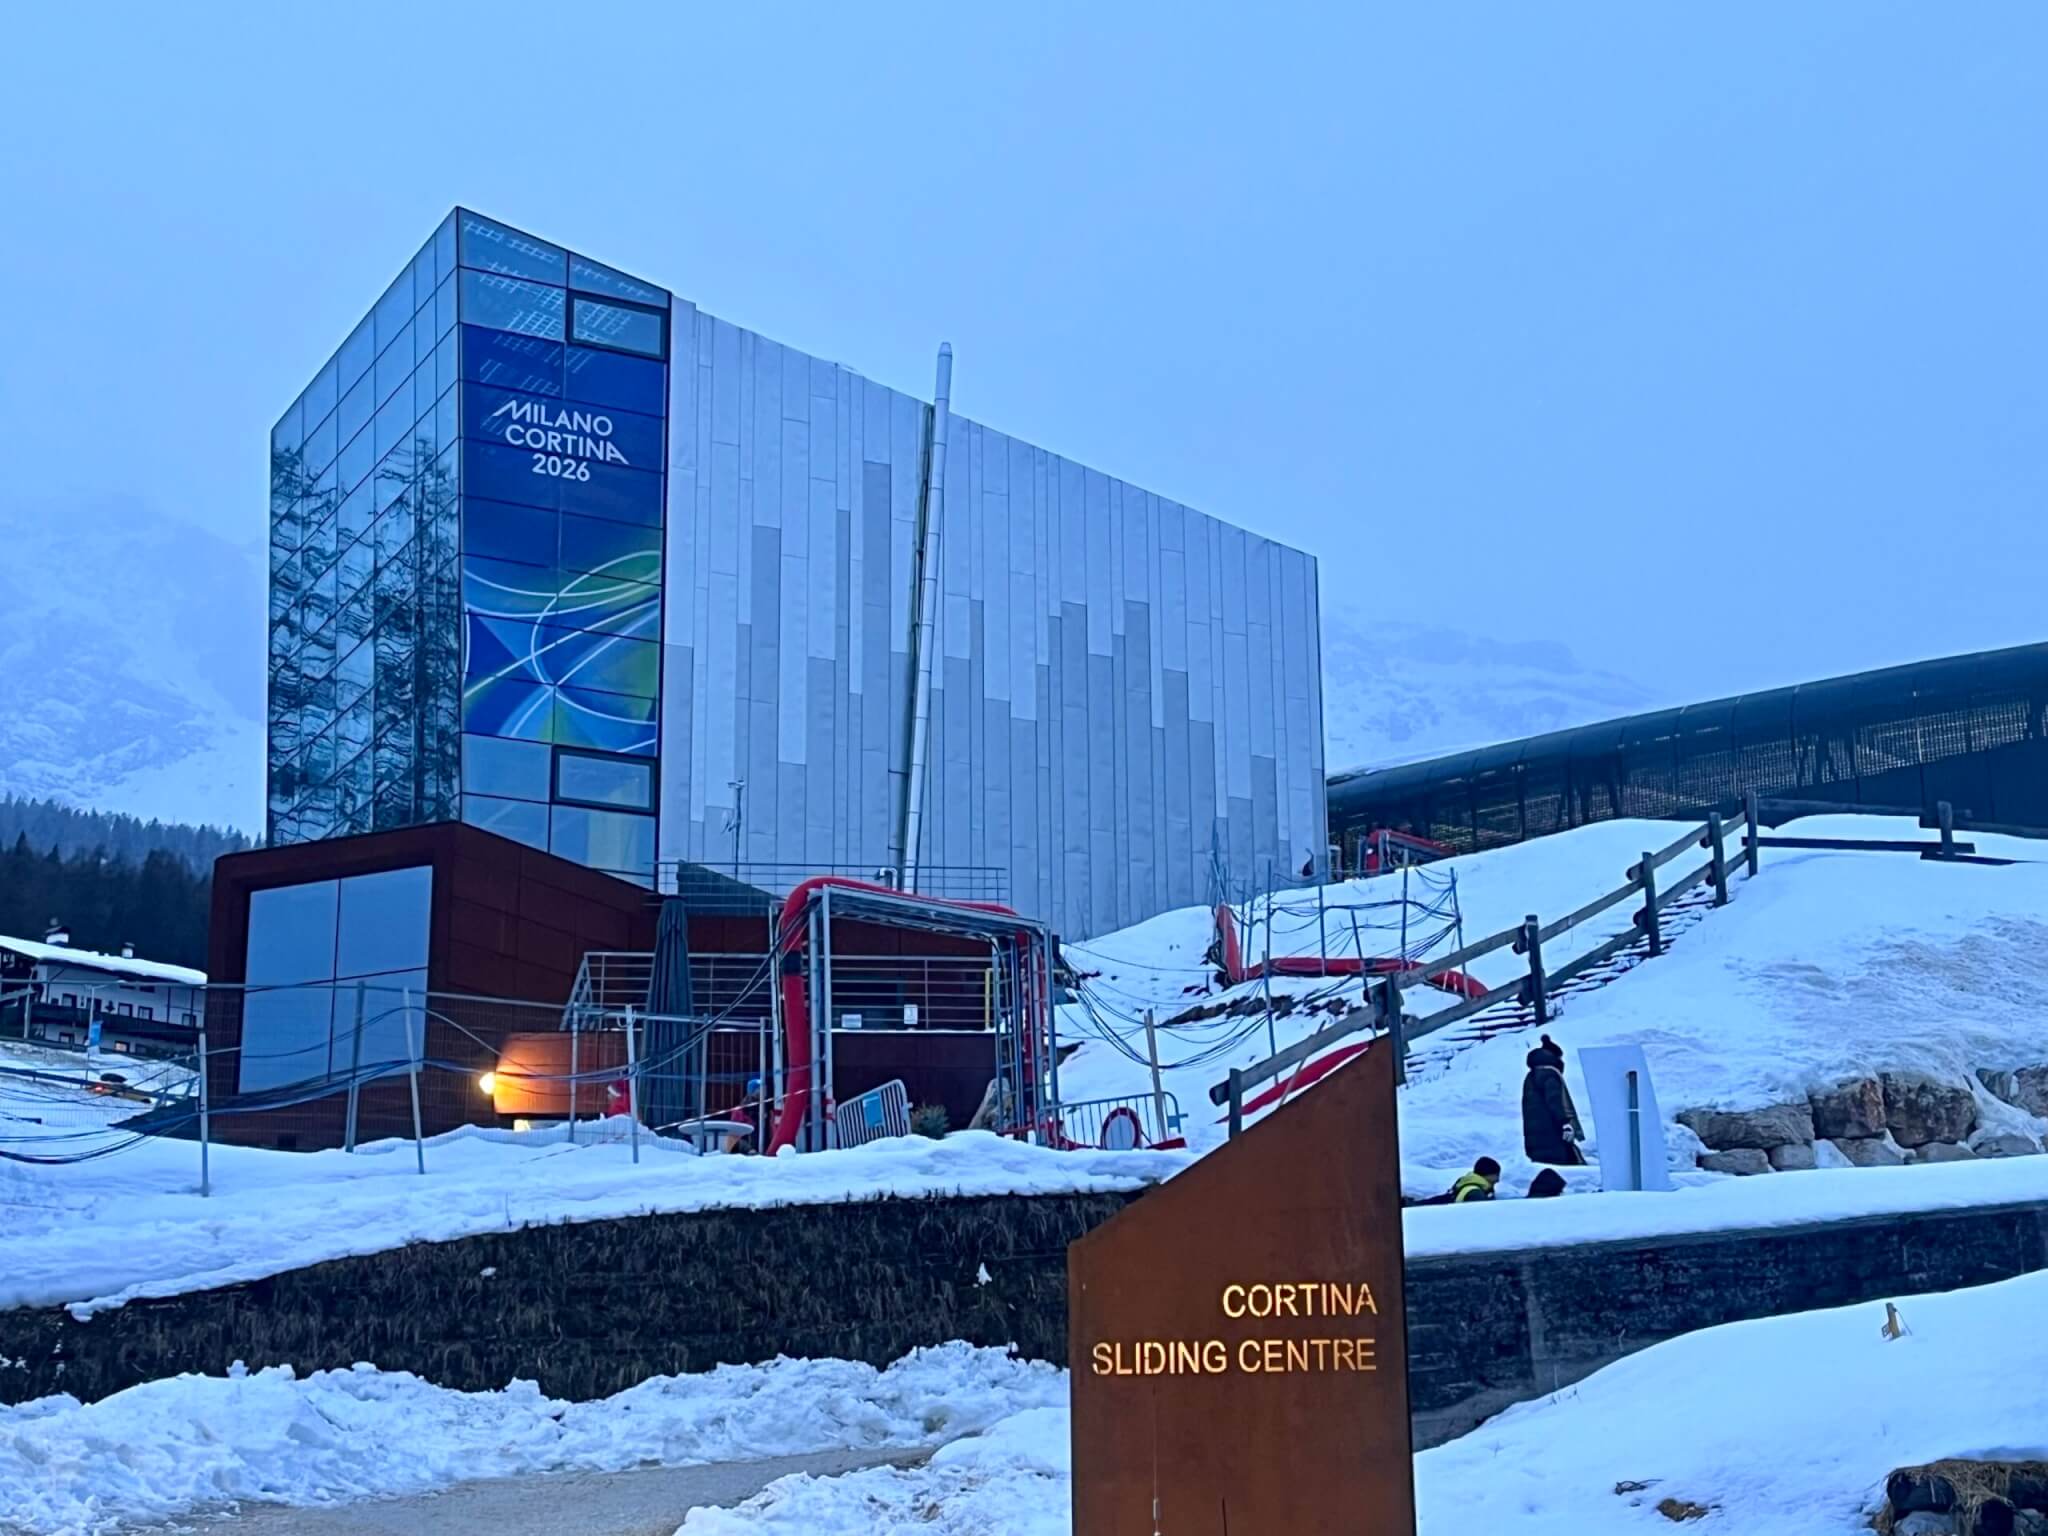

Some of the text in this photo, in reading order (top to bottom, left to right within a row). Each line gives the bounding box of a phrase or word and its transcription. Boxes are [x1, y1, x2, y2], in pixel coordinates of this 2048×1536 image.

[493, 400, 613, 436] MILANO
[506, 424, 629, 465] CORTINA
[532, 453, 590, 482] 2026
[1223, 1283, 1378, 1318] CORTINA
[1092, 1338, 1377, 1375] SLIDING CENTRE
